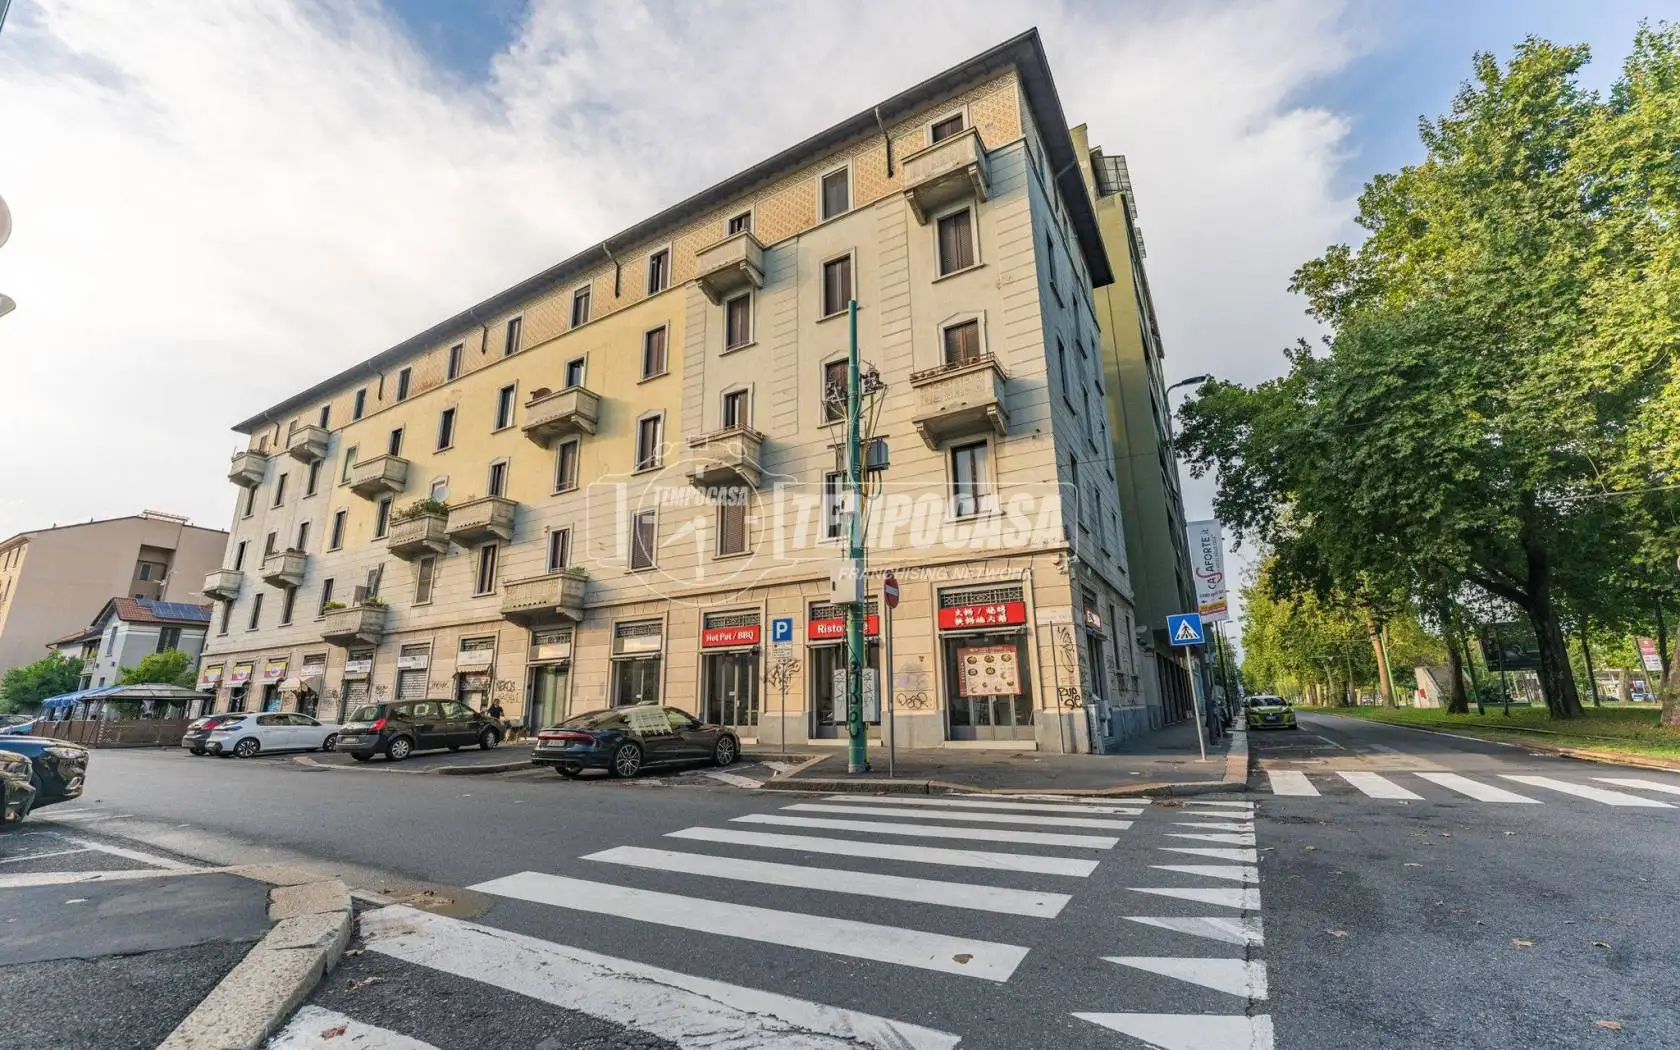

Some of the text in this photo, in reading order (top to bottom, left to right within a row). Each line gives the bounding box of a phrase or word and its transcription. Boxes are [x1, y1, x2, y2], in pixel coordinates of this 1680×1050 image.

[706, 632, 719, 642] Hot
[719, 632, 732, 642] Pot
[737, 630, 754, 641] BBQ
[776, 621, 788, 639] P
